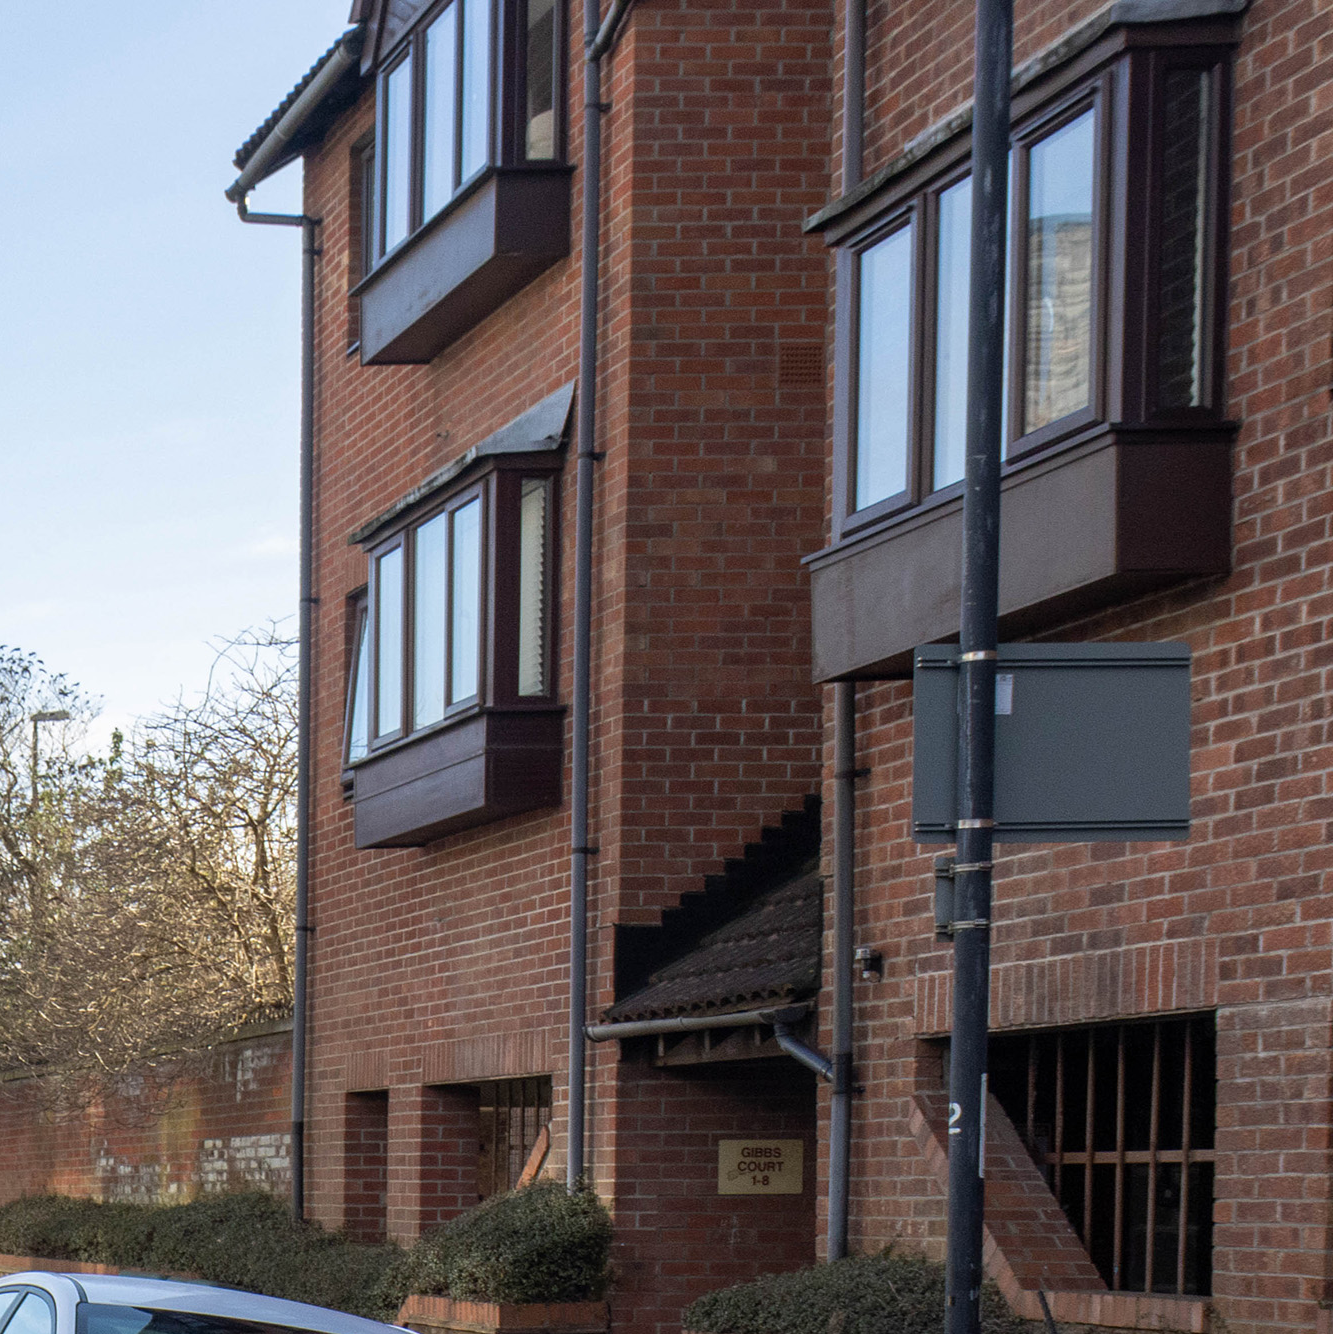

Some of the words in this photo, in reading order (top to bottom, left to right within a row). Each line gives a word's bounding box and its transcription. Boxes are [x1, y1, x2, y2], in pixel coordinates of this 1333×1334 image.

[741, 1147, 782, 1159] GIBBS
[737, 1161, 784, 1172] COURT
[752, 1175, 770, 1186] 1-8
